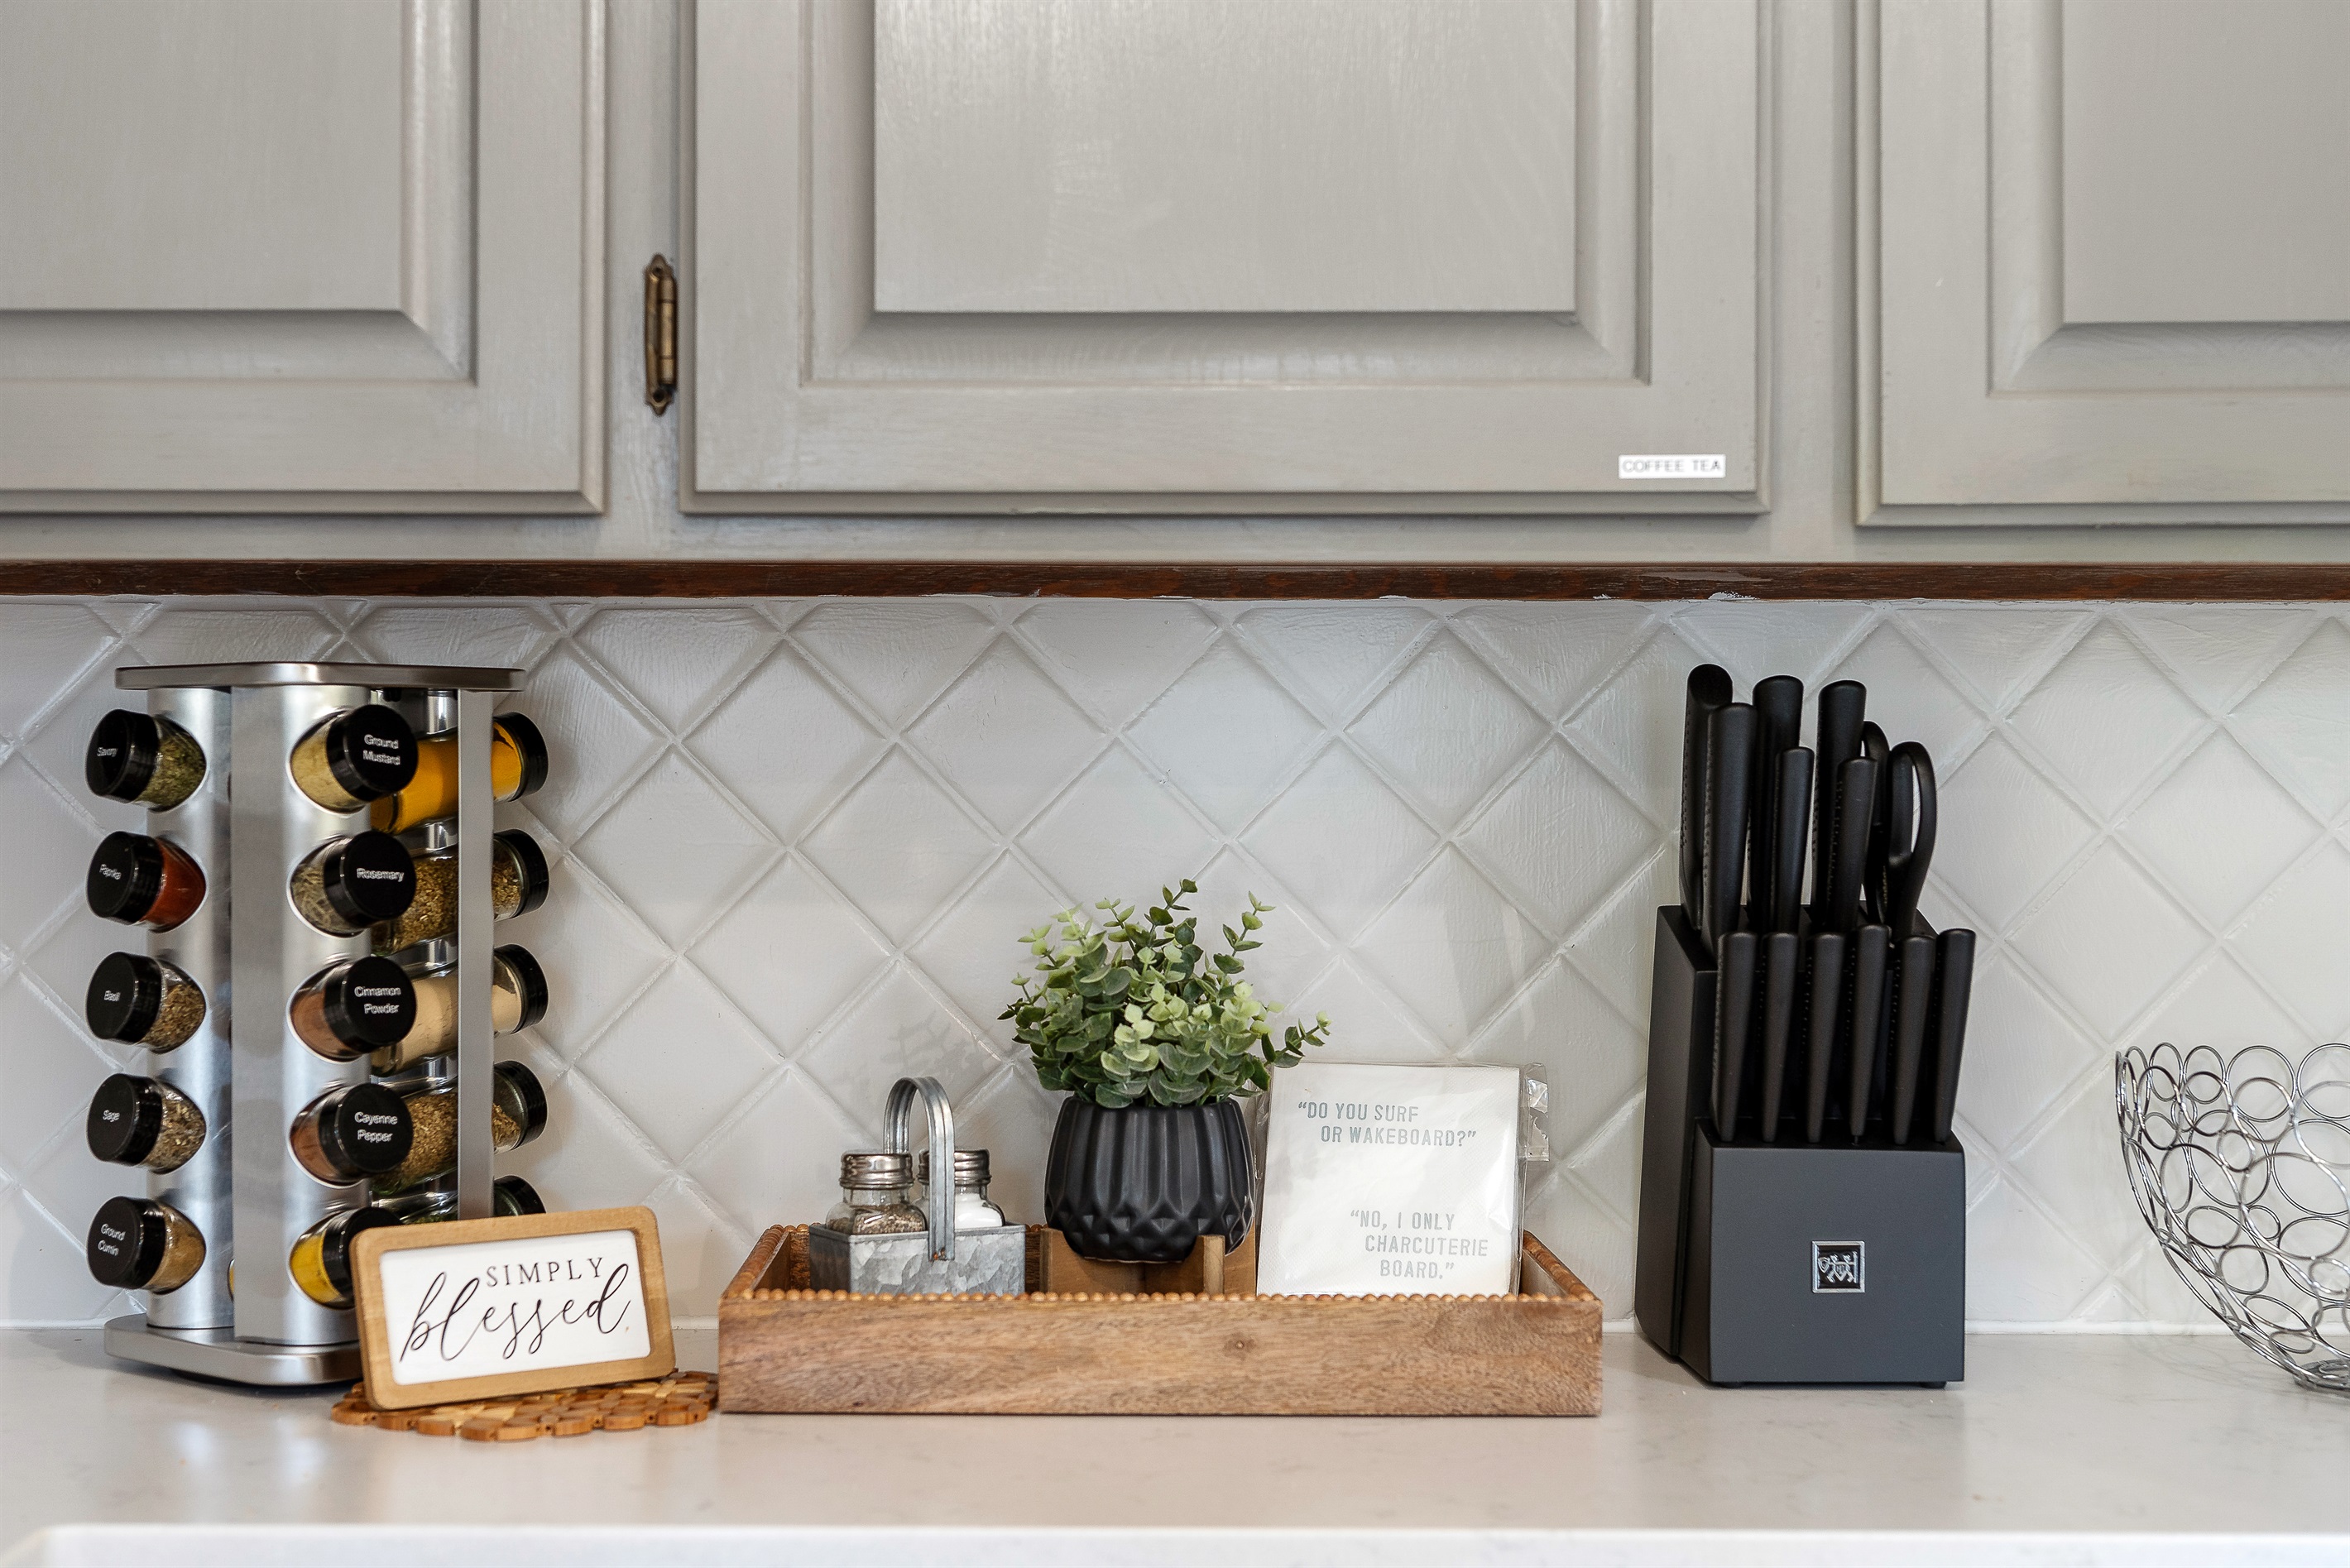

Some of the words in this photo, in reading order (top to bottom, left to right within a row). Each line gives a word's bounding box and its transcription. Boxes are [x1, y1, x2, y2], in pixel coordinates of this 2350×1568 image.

[1623, 459, 1685, 473] COFFEE
[1692, 459, 1720, 473] TEA
[364, 734, 399, 750] Ground
[363, 750, 400, 765] Mustard
[357, 867, 405, 882] Rosemary
[354, 986, 401, 998] Cinnamon
[364, 1003, 400, 1014] Powder
[103, 1110, 120, 1122] Sage
[354, 1111, 398, 1125] Cayenne
[1336, 1103, 1368, 1120] YOU
[1374, 1105, 1419, 1123] SURF
[357, 1129, 393, 1143] Pepper
[1321, 1125, 1343, 1144] OR
[1412, 1212, 1455, 1230] ONLY
[100, 1223, 126, 1241] Ground
[98, 1240, 119, 1256] Cumin
[1365, 1235, 1489, 1257] CHARCUTERIE
[487, 1257, 604, 1287] SIMPLY
